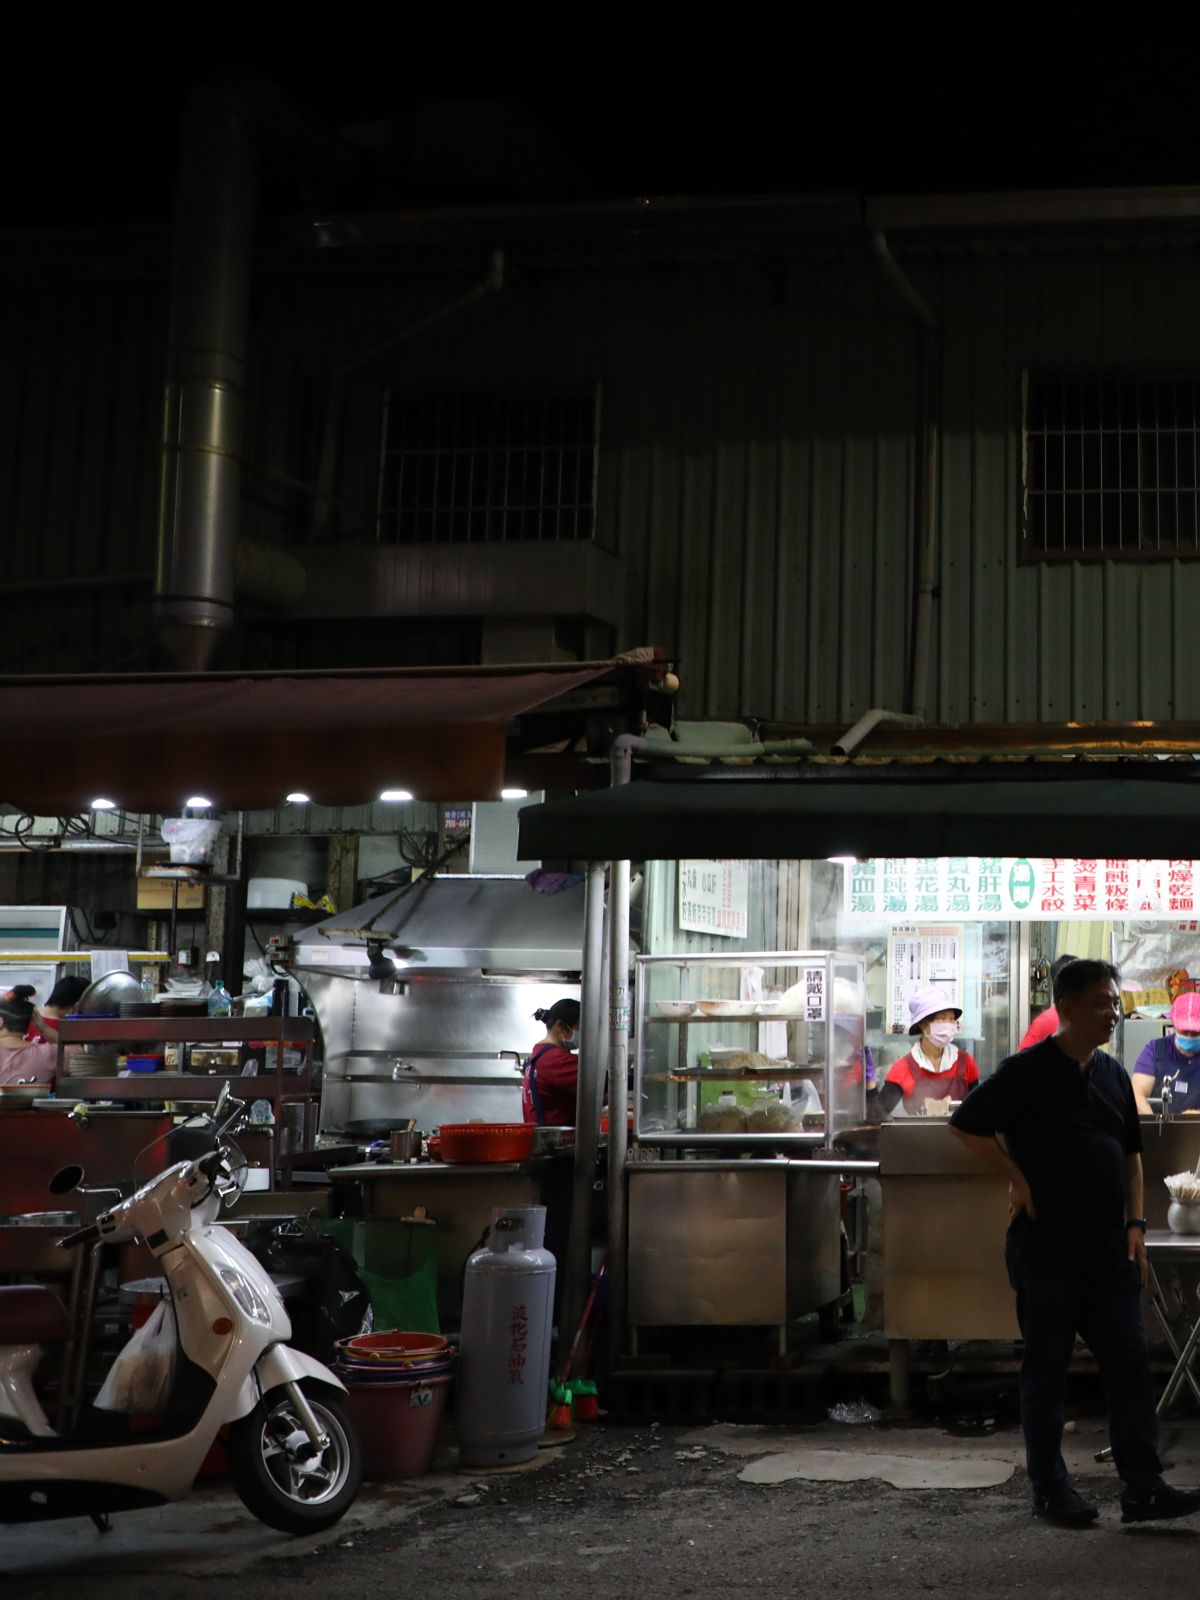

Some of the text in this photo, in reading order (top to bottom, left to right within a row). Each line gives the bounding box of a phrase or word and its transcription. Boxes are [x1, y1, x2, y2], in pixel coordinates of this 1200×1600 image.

[851, 859, 876, 912] 豬血湯
[978, 858, 1003, 912] 豬肝湯
[1041, 858, 1065, 911] 手工水餃
[806, 970, 823, 1020] 請戴口罩
